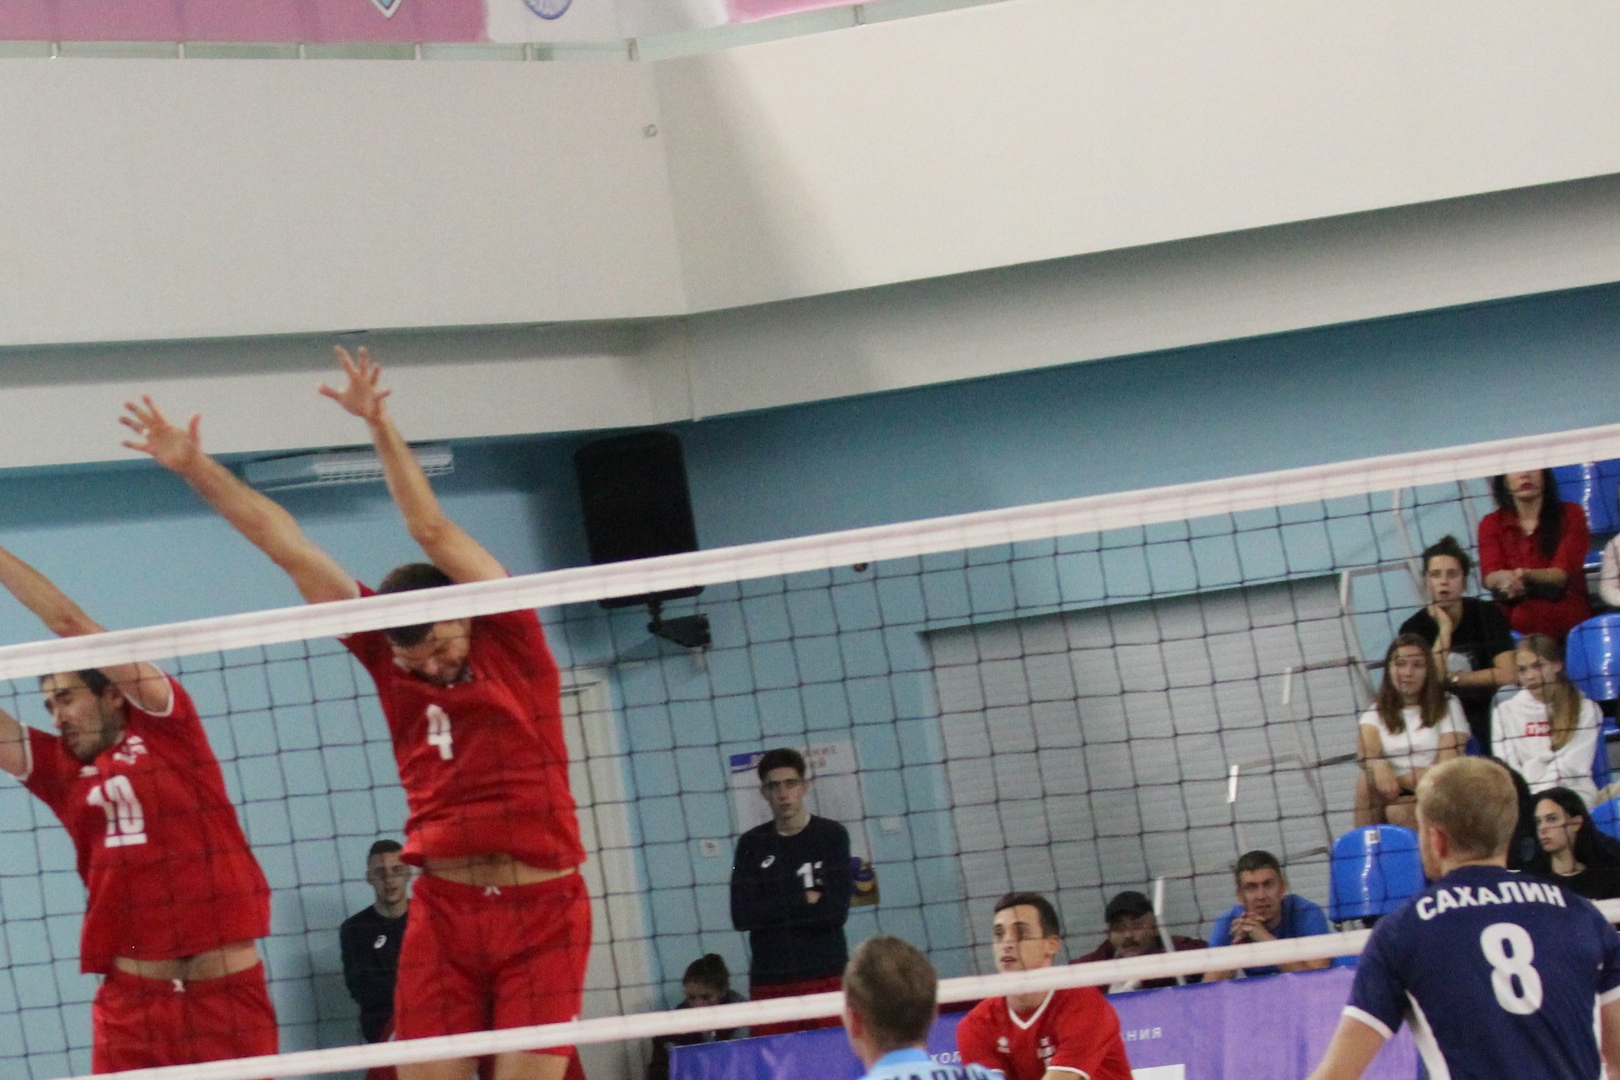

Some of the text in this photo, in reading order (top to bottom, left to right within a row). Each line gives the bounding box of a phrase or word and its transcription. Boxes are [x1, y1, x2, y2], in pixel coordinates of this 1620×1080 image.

[425, 704, 454, 760] 4
[86, 775, 145, 837] 10
[1416, 881, 1567, 921] САХАЛИН
[1480, 922, 1544, 1015] 8
